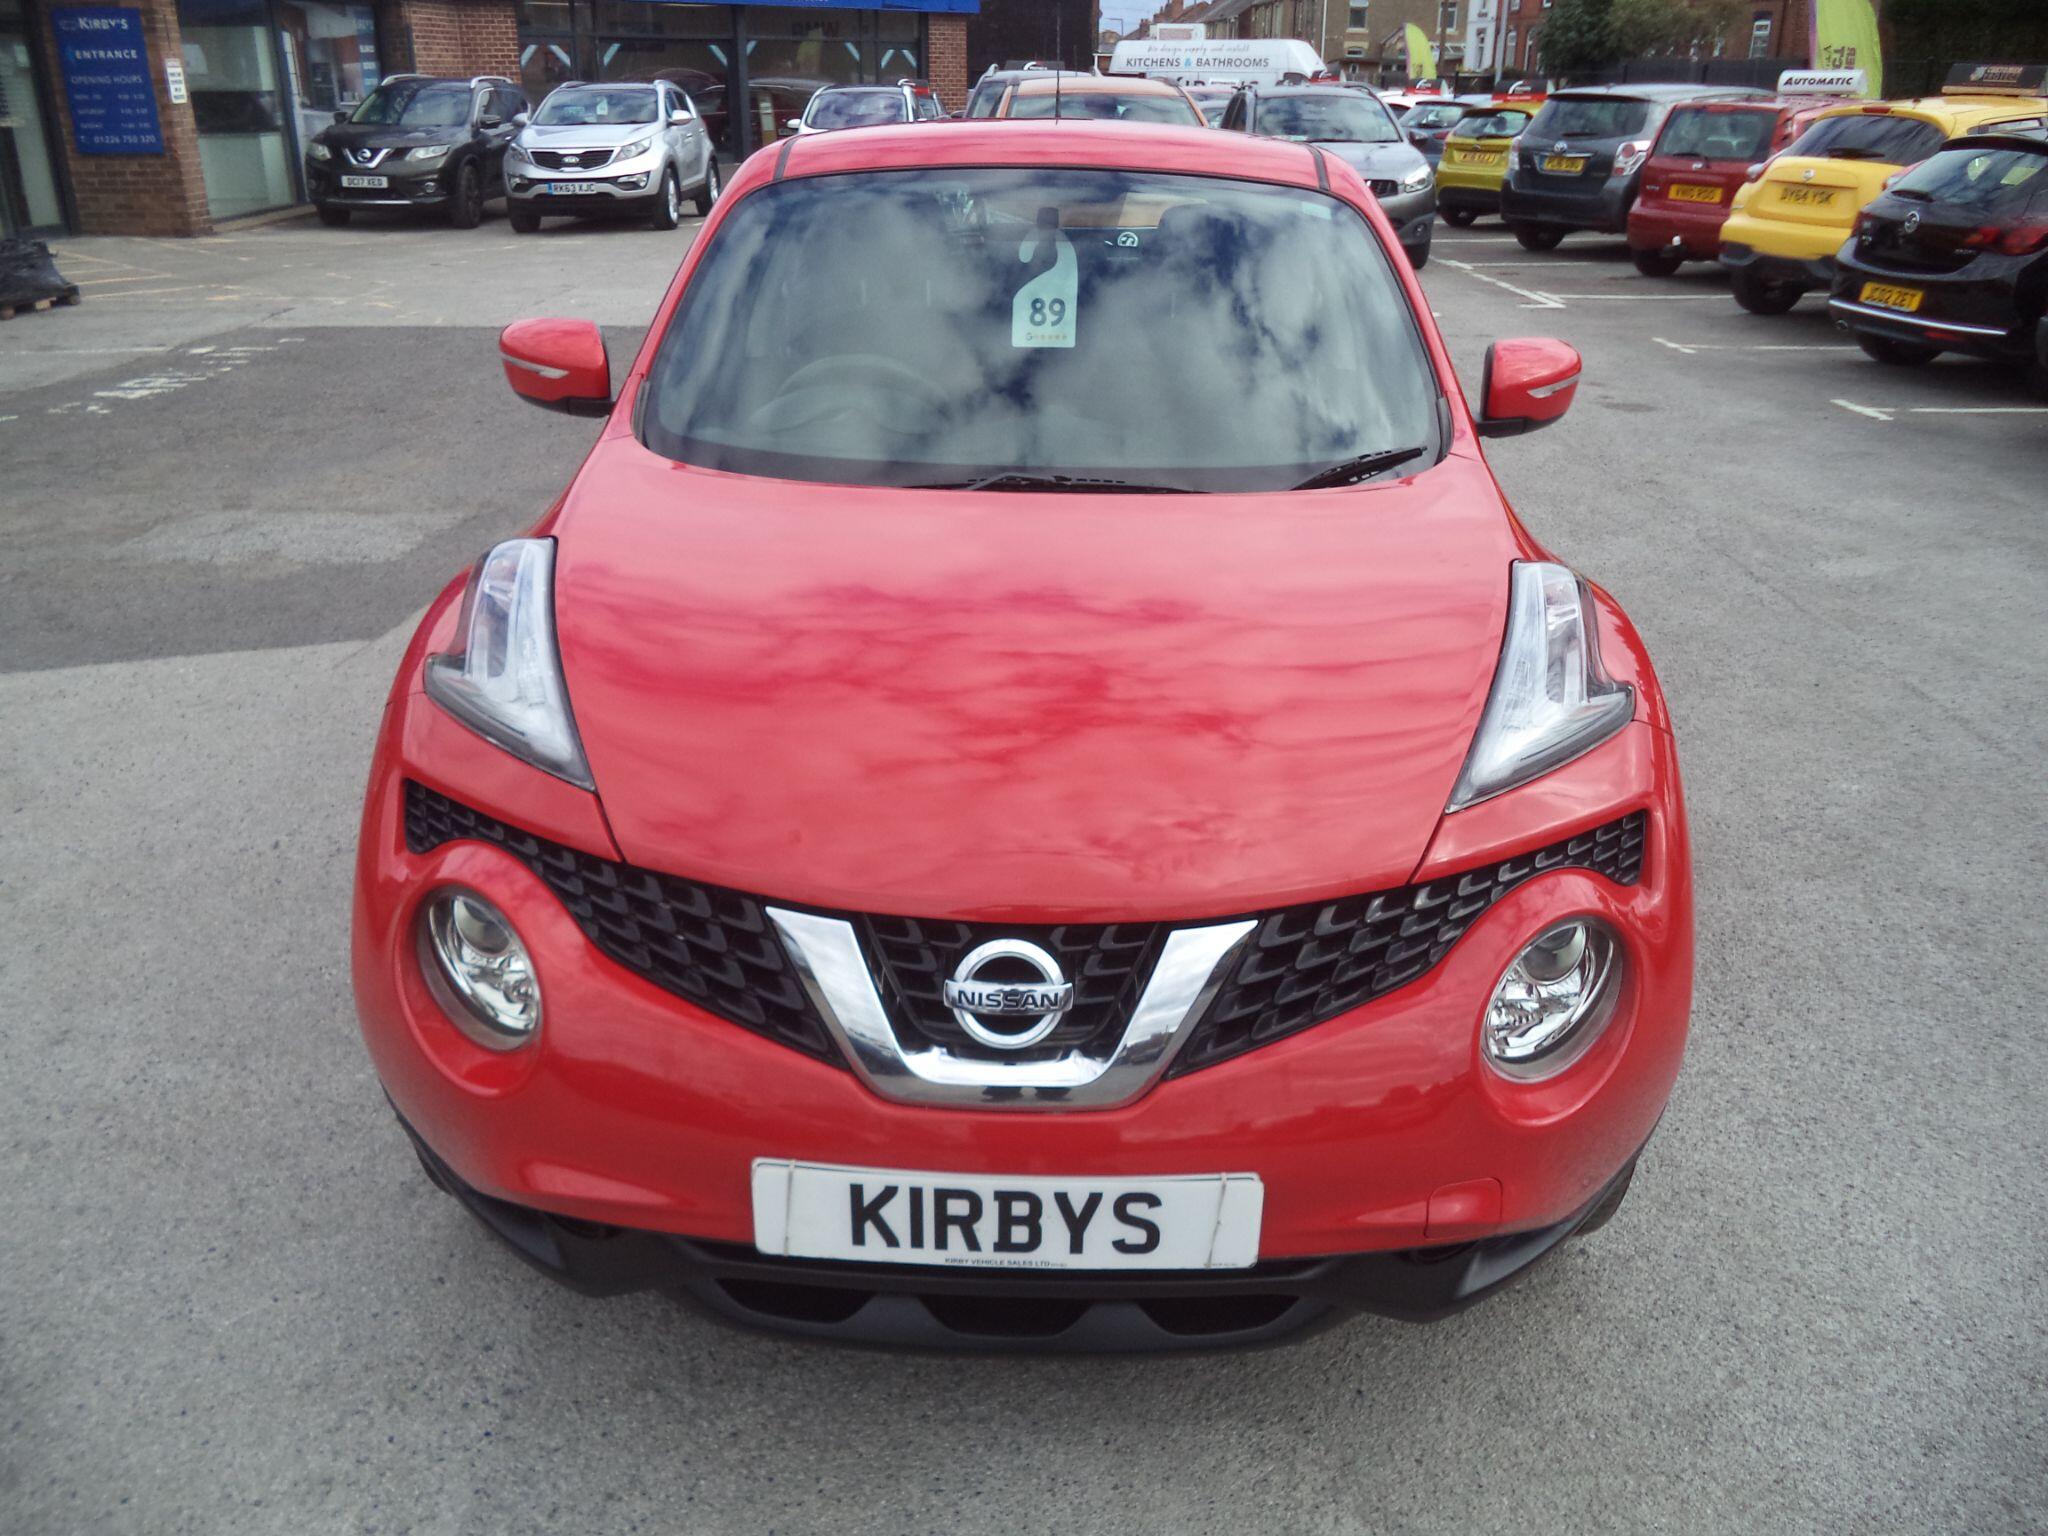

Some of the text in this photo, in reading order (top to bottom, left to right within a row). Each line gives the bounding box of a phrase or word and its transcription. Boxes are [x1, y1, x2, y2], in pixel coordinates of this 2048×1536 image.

[78, 17, 128, 30] KIRBY'S
[75, 49, 138, 60] ENTRANCE
[1126, 57, 1181, 68] KITCHENS
[1196, 57, 1270, 68] BATHROOMS
[1783, 76, 1854, 86] AUTOMATIC
[553, 183, 576, 193] RK63
[1029, 297, 1066, 327] 89
[957, 989, 1059, 1009] NISSAN
[849, 1182, 1162, 1255] KIRBYS
